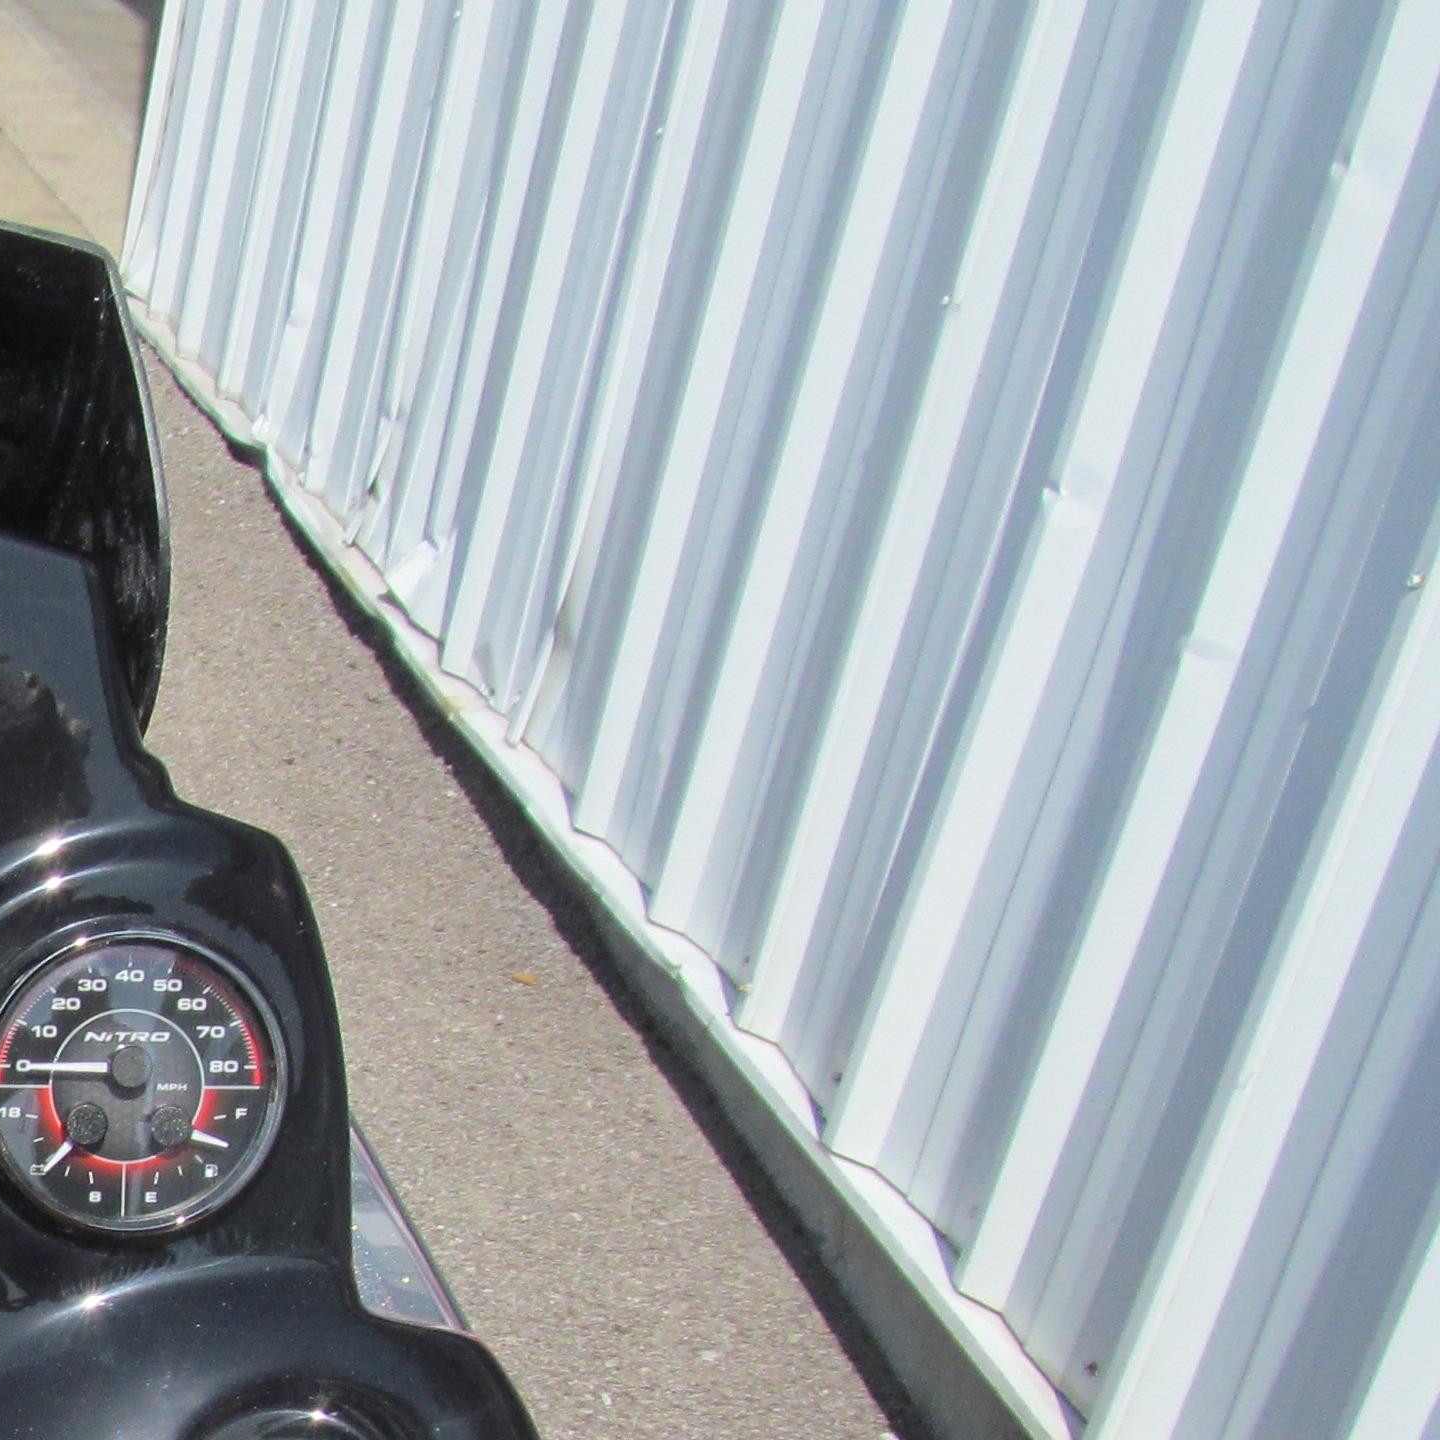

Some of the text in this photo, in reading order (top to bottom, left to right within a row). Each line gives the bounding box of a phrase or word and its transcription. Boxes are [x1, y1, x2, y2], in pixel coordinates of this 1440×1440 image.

[115, 969, 144, 983] 40
[78, 979, 106, 992] 30
[153, 979, 183, 992] 50
[51, 998, 81, 1011] 20
[177, 998, 207, 1011] 60
[31, 1026, 57, 1039] 10
[196, 1026, 225, 1039] 70
[16, 1060, 32, 1072] 0
[209, 1060, 239, 1073] 80
[157, 1083, 188, 1092] MPH
[236, 1107, 247, 1119] F
[145, 1192, 157, 1203] E
